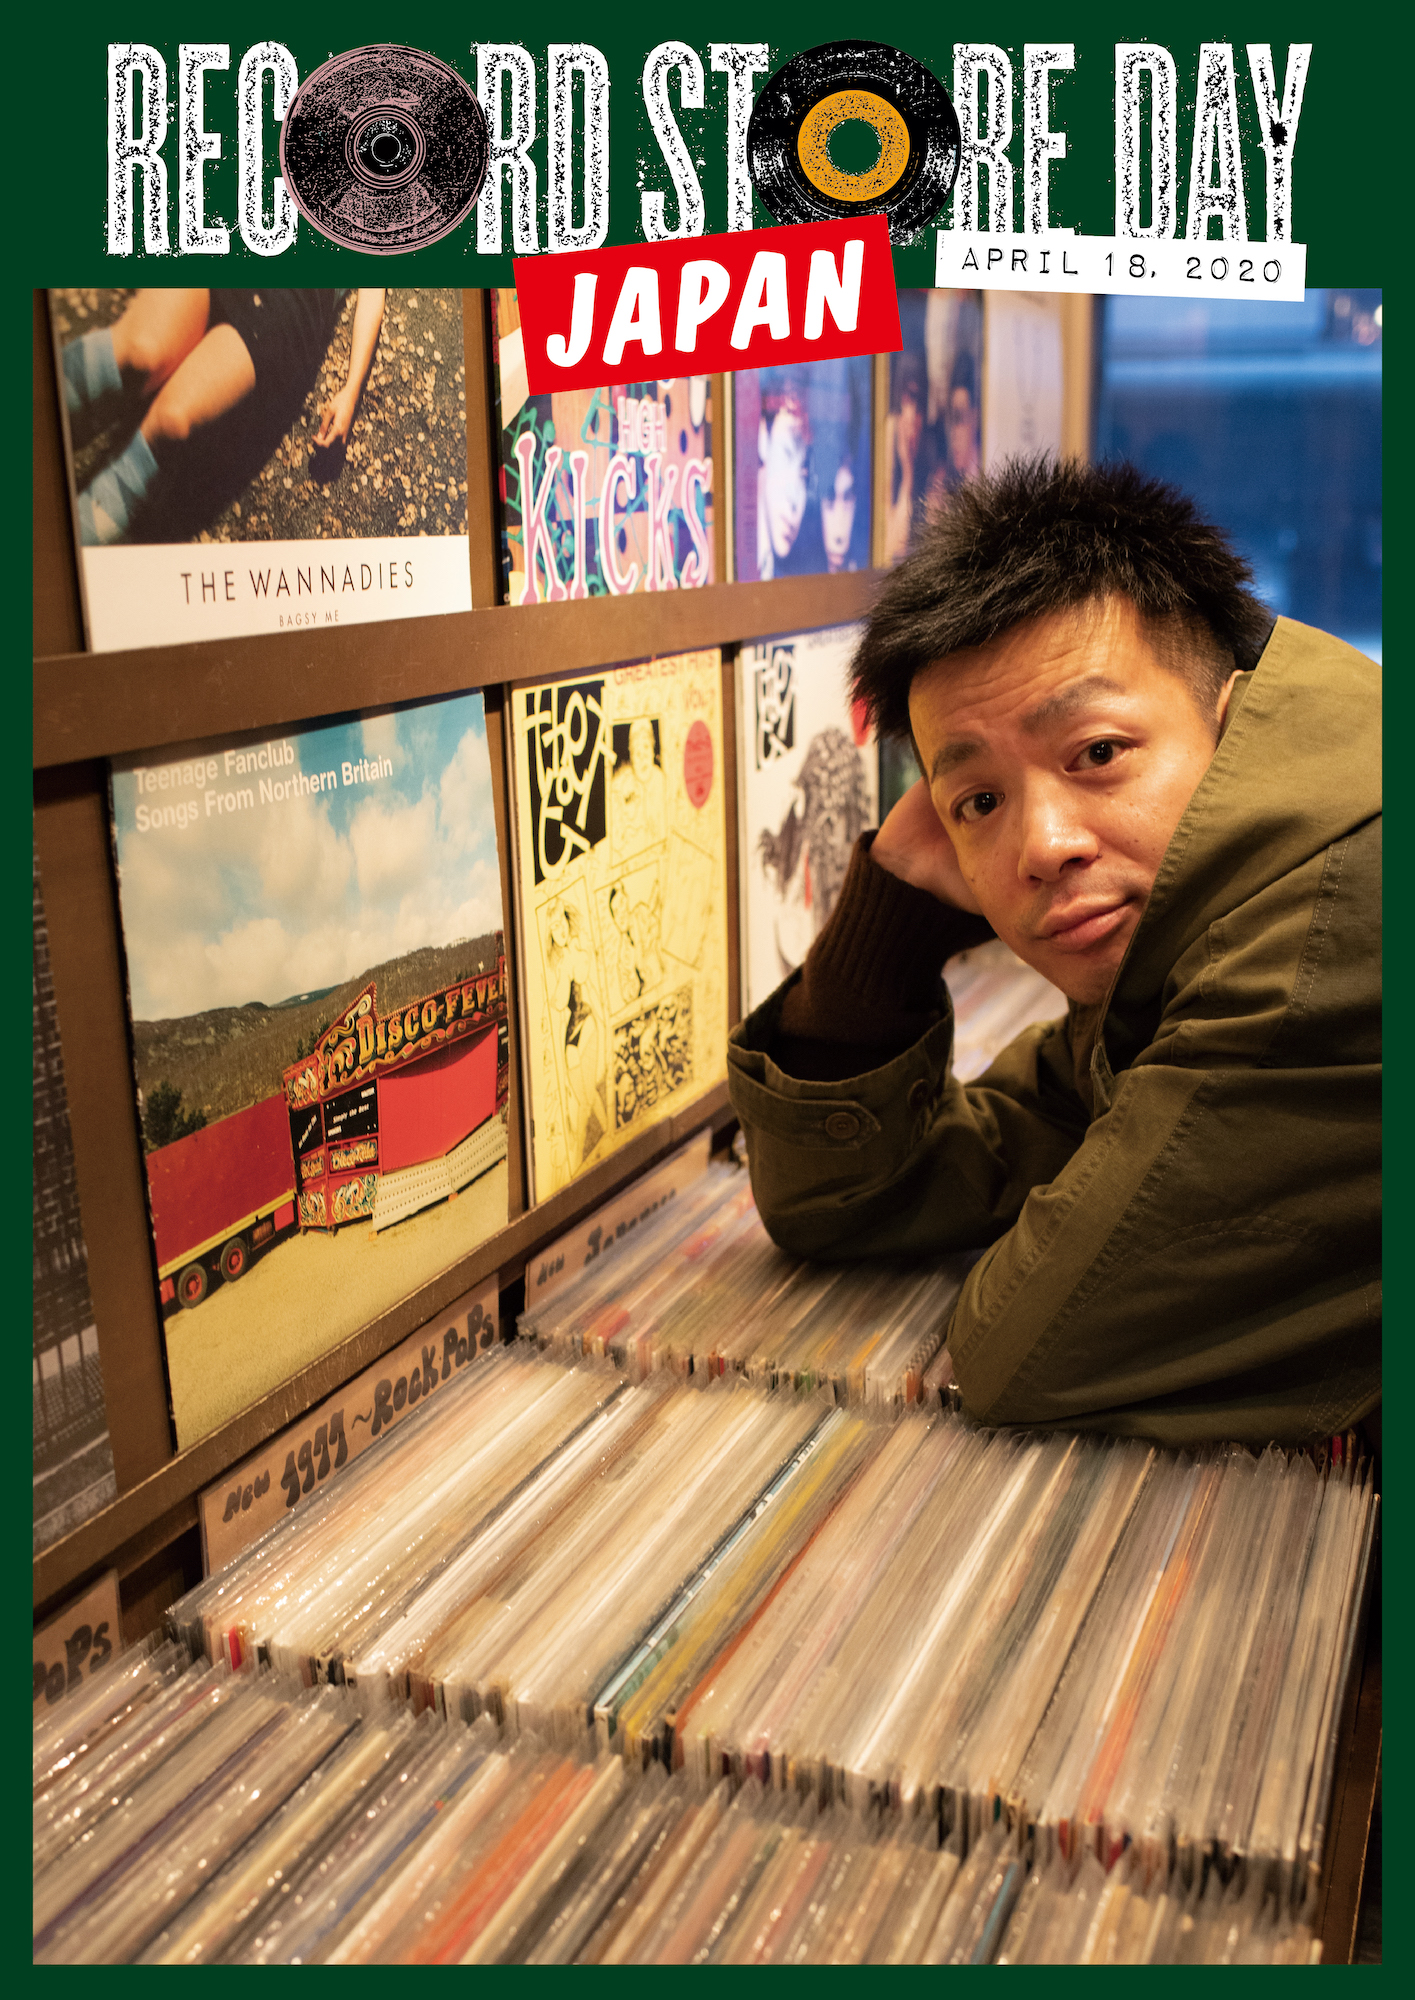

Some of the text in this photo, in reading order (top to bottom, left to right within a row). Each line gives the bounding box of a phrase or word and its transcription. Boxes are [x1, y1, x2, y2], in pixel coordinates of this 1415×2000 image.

[514, 431, 714, 606] KICKS
[181, 560, 414, 604] THE WANNADIES
[279, 609, 340, 628] BAGSY ME
[133, 739, 295, 795] Teenage Fanclub
[135, 754, 393, 833] Songs From Northern Britain
[222, 1469, 270, 1523] New
